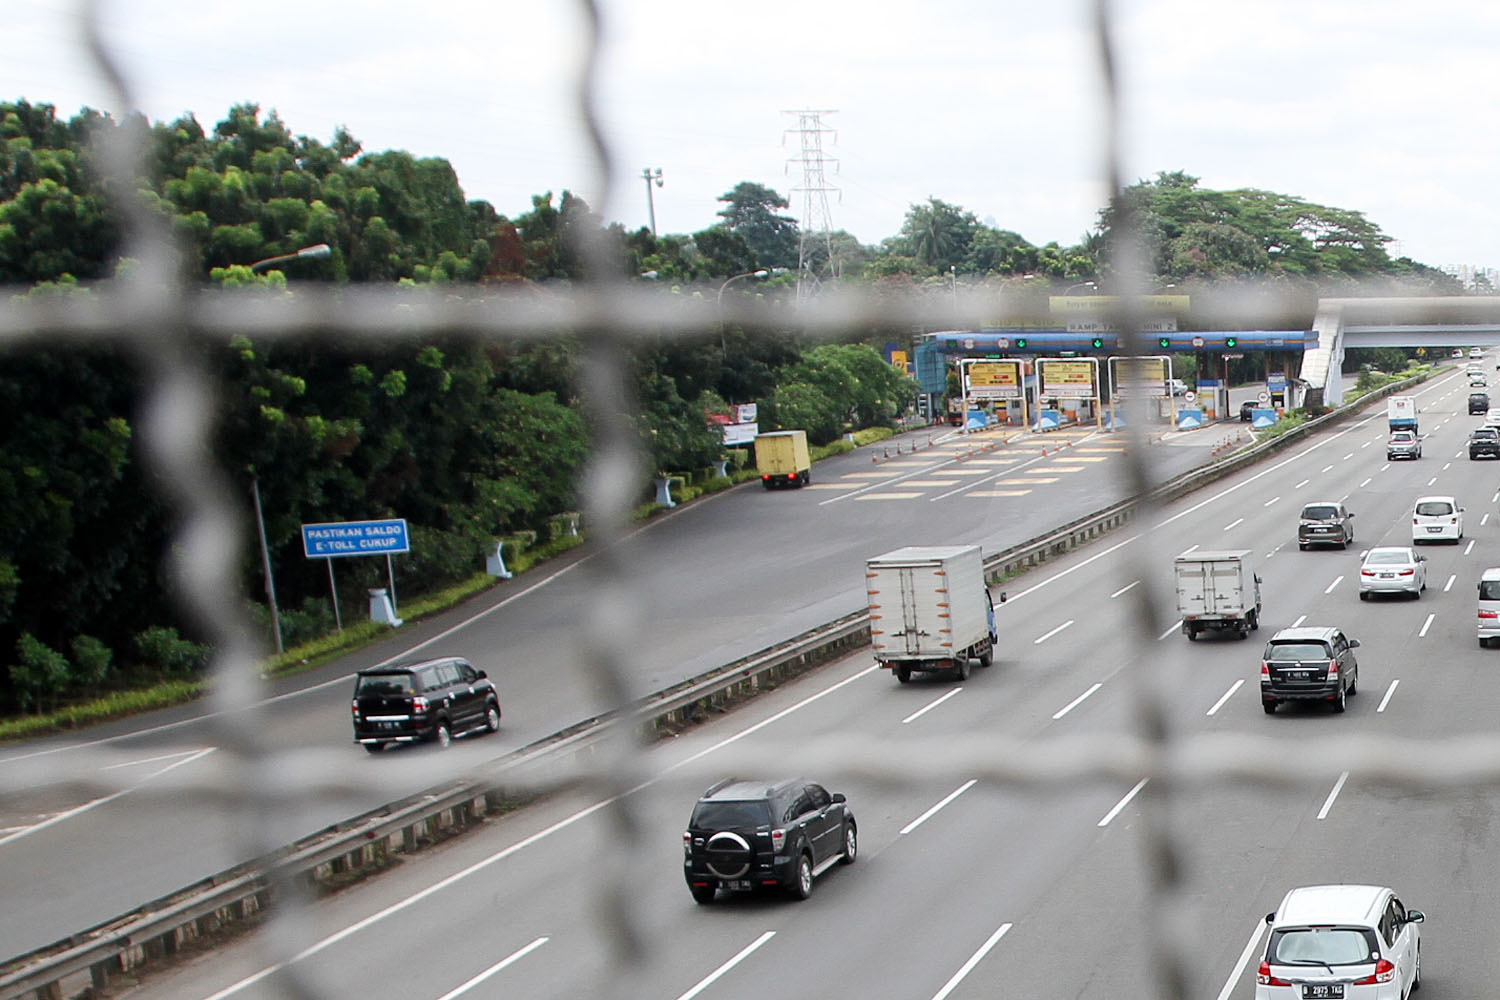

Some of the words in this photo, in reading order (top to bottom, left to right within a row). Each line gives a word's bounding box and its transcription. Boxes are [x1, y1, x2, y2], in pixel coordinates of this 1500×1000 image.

[307, 528, 362, 539] PASTIKAN
[365, 525, 401, 536] SALDO
[315, 540, 356, 551] E-TOLL
[359, 537, 397, 548] CUKUP
